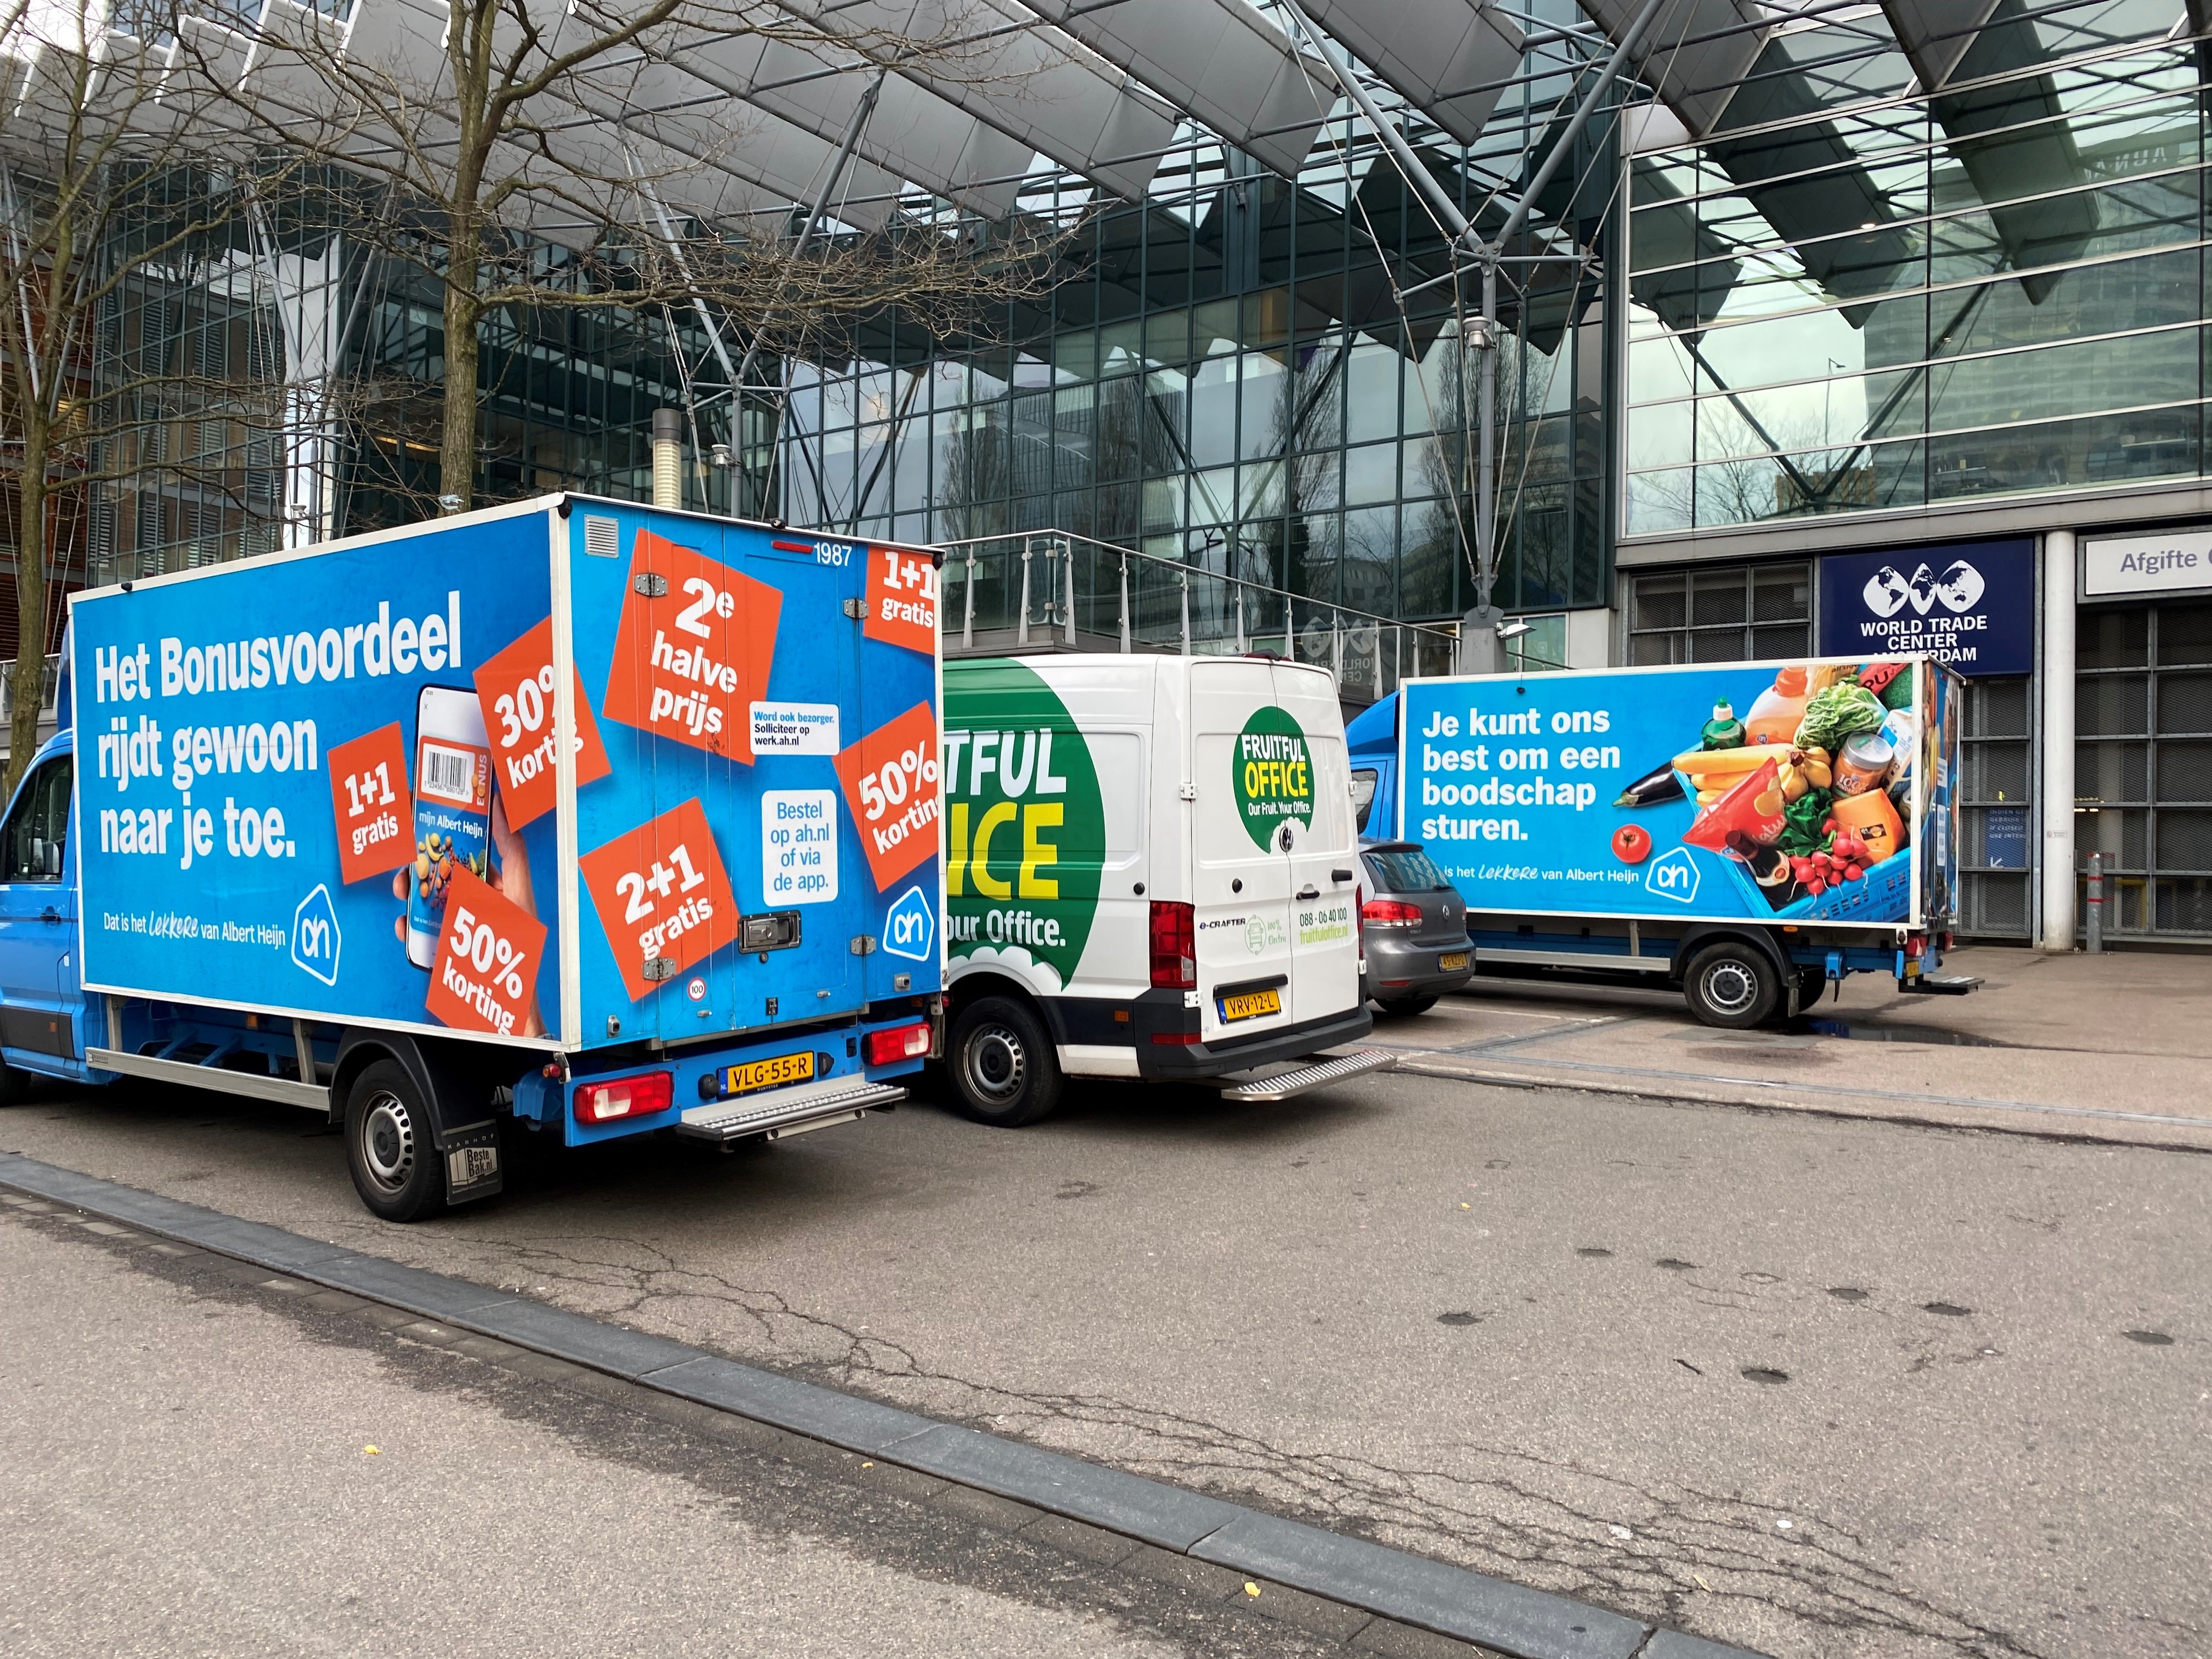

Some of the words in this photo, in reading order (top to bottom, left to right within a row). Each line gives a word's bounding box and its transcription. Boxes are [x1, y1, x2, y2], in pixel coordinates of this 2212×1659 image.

[813, 541, 852, 566] 1987
[2120, 550, 2198, 574] Afgifte
[883, 551, 934, 600] 1+1
[675, 577, 735, 639] 2e
[881, 597, 934, 628] gratis
[1860, 620, 1923, 636] WORLD
[1928, 615, 1988, 633] TRADE
[95, 644, 150, 703] Het
[160, 590, 461, 697] Bonusvoordeel
[1888, 633, 1957, 650] CENTER
[650, 630, 737, 693] halve
[650, 687, 723, 736] prijs
[754, 711, 777, 721] Word
[780, 712, 795, 722] ook
[798, 712, 834, 725] bezorger.
[1422, 711, 1459, 737] Je
[1470, 708, 1541, 736] kunt
[1551, 710, 1611, 733] ons
[754, 723, 797, 733] Solliciteer
[799, 726, 810, 736] op
[755, 736, 799, 746] werk.ah.nl
[98, 715, 162, 792] rijdt
[172, 719, 318, 790] gewoon
[1242, 734, 1306, 762] FRUITFUL
[1423, 744, 1489, 771] best
[1498, 747, 1548, 770] om
[1560, 746, 1621, 769] een
[345, 761, 396, 817] 1+1
[476, 754, 487, 806] BNUS
[858, 740, 938, 821] 50%
[1245, 761, 1308, 798] OFFICE
[1422, 777, 1596, 811] boodschap
[777, 800, 822, 820] Bestel
[1248, 802, 1261, 816] Our
[1262, 801, 1278, 815] Fruit.
[1278, 801, 1293, 815] Your
[1293, 801, 1311, 814] Office.
[100, 808, 172, 854] naar
[180, 792, 213, 870] je
[224, 797, 296, 857] toe.
[352, 812, 399, 855] gratis
[419, 811, 435, 826] mijn
[437, 815, 461, 832] Albert
[462, 824, 483, 839] Heijn
[770, 828, 789, 847] op
[795, 823, 829, 842] ah.nl
[872, 794, 938, 855] kortin
[1421, 814, 1528, 840] sturen.
[781, 848, 796, 867] of
[800, 847, 821, 865] via
[616, 843, 705, 926] 2+1
[774, 872, 792, 891] de
[798, 874, 828, 893] app.
[1457, 866, 1475, 877] het
[1541, 871, 1562, 880] van
[1566, 868, 1604, 882] Albert
[1607, 870, 1639, 884] Heijn
[104, 912, 120, 931] Dat
[121, 913, 129, 932] is
[131, 913, 146, 933] het
[201, 924, 219, 940] van
[222, 921, 255, 944] Albert
[258, 924, 285, 950] Heijn
[639, 895, 713, 961] gratis
[986, 909, 1066, 947] Office.
[1268, 919, 1282, 931] 100%
[1300, 912, 1313, 927] 088
[1319, 910, 1327, 923] 06
[1329, 909, 1337, 922] 40
[1337, 907, 1347, 921] 100
[1268, 934, 1286, 945] Electric
[1300, 923, 1348, 945] fruitfuloffice.nl
[449, 906, 526, 999] 50%
[442, 956, 515, 1035] korting
[690, 984, 703, 994] 100
[1229, 994, 1274, 1015] VRV-12-L
[733, 1057, 807, 1088] VLG-55-R
[448, 1134, 494, 1149] KARHOF
[467, 1149, 489, 1163] Beste
[469, 1159, 493, 1178] Bak.nl
